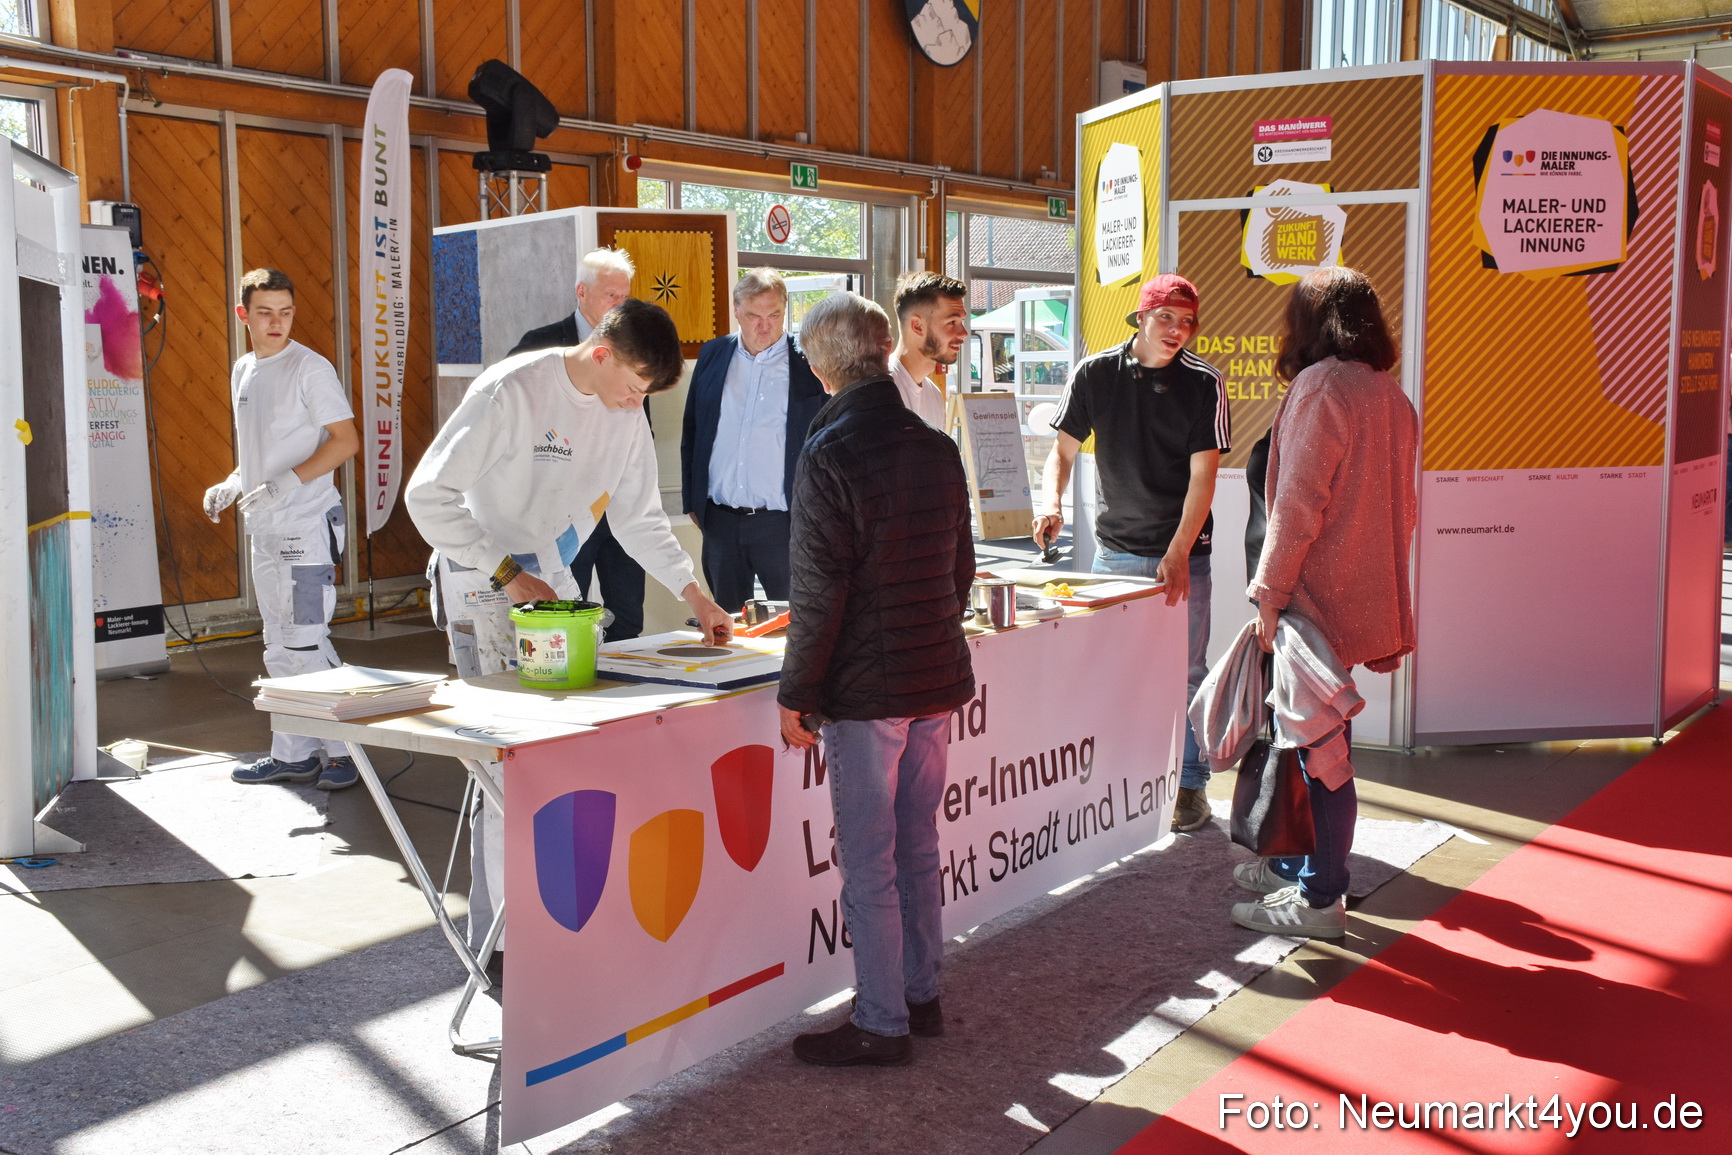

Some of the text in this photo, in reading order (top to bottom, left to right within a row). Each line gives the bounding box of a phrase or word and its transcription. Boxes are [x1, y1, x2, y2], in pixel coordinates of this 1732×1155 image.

[1278, 121, 1326, 131] HANDWERK
[1541, 151, 1611, 160] DIE INNUNGS-
[1540, 161, 1576, 170] MALER
[1120, 174, 1138, 185] INNUNGS-
[1114, 186, 1126, 195] MALER
[1502, 198, 1606, 214] MALER- UND
[1102, 216, 1137, 234] MALER- UND
[1277, 220, 1318, 233] ZUKUNFT
[1504, 218, 1604, 234] LACKIERER-
[1102, 235, 1136, 252] LACKIERER-
[1277, 230, 1317, 246] HAND
[1520, 238, 1586, 252] INNUNG
[389, 218, 402, 290] MALER/-IN
[1108, 253, 1130, 268] INNUNG
[1276, 246, 1316, 260] WERK
[374, 124, 392, 511] DEINE ZUKUNFT IST BUNT
[394, 295, 405, 384] AUSBILDUNG:
[1196, 336, 1236, 354] DAS
[973, 411, 1017, 420] Gewinnspiel
[1436, 524, 1515, 534] www.neumarkt.de
[988, 810, 1060, 882] Stadt
[1068, 784, 1114, 846] und
[1123, 757, 1178, 822] Land
